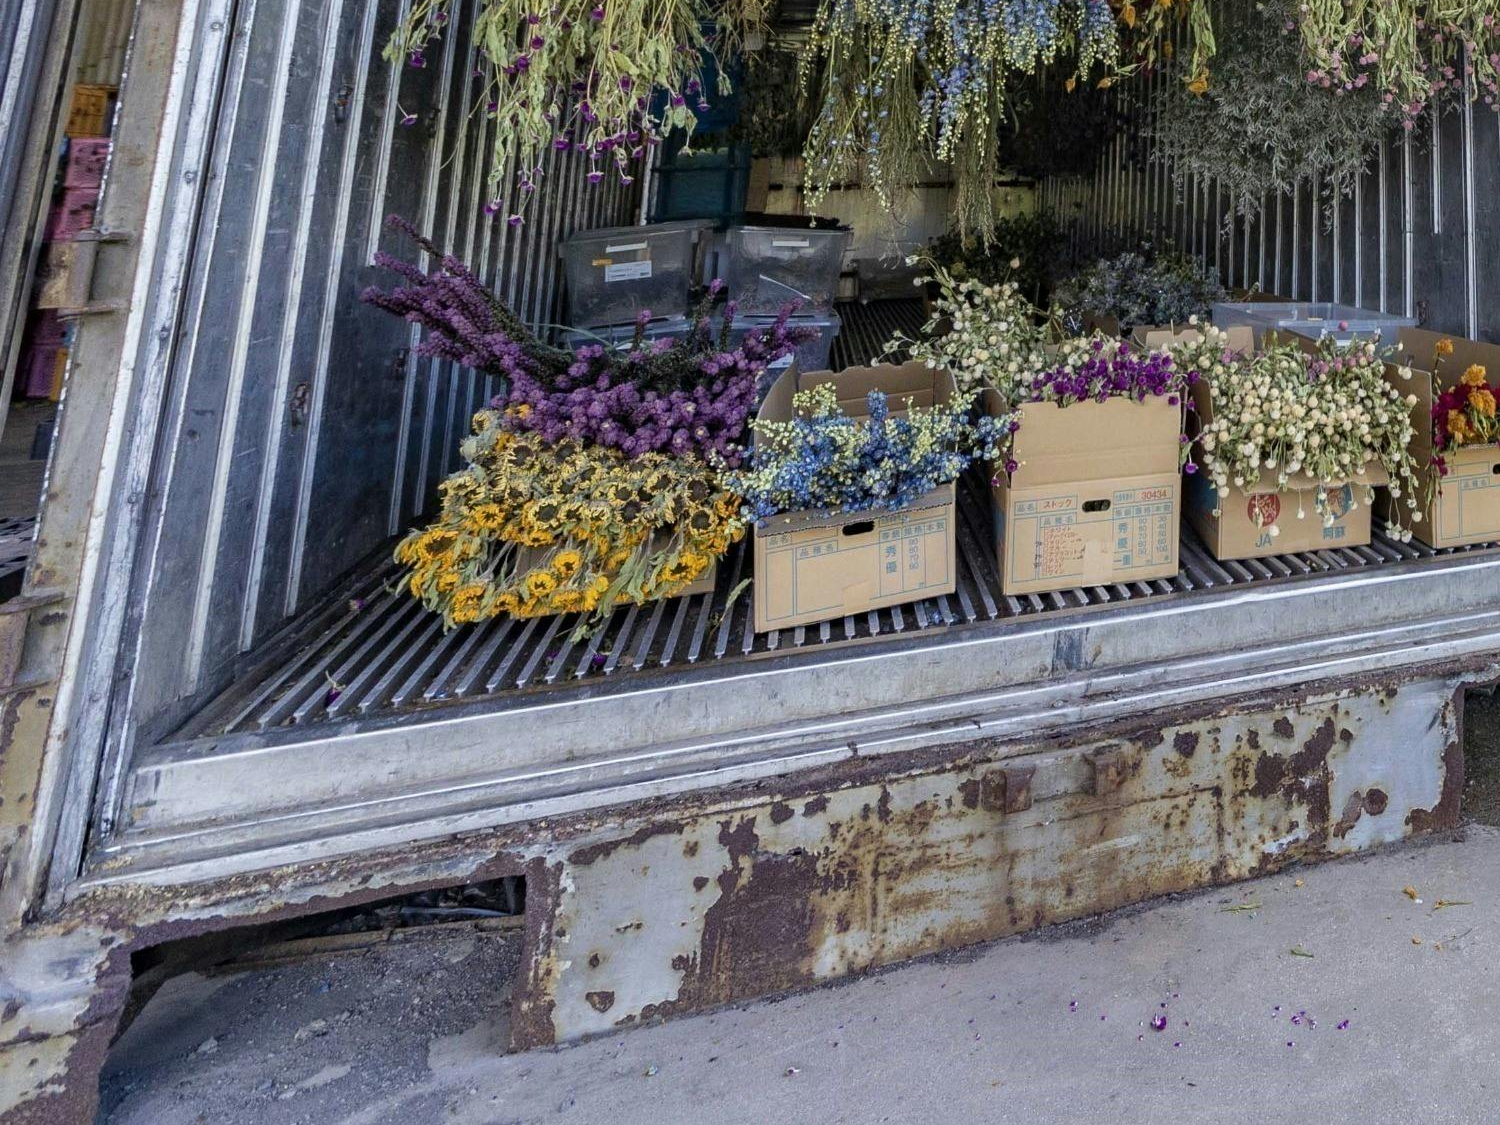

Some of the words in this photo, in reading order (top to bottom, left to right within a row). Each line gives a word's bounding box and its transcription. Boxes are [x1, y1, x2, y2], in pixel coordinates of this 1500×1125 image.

[1140, 488, 1168, 501] 30434
[1043, 498, 1072, 509] ストック
[1255, 534, 1272, 548] JA
